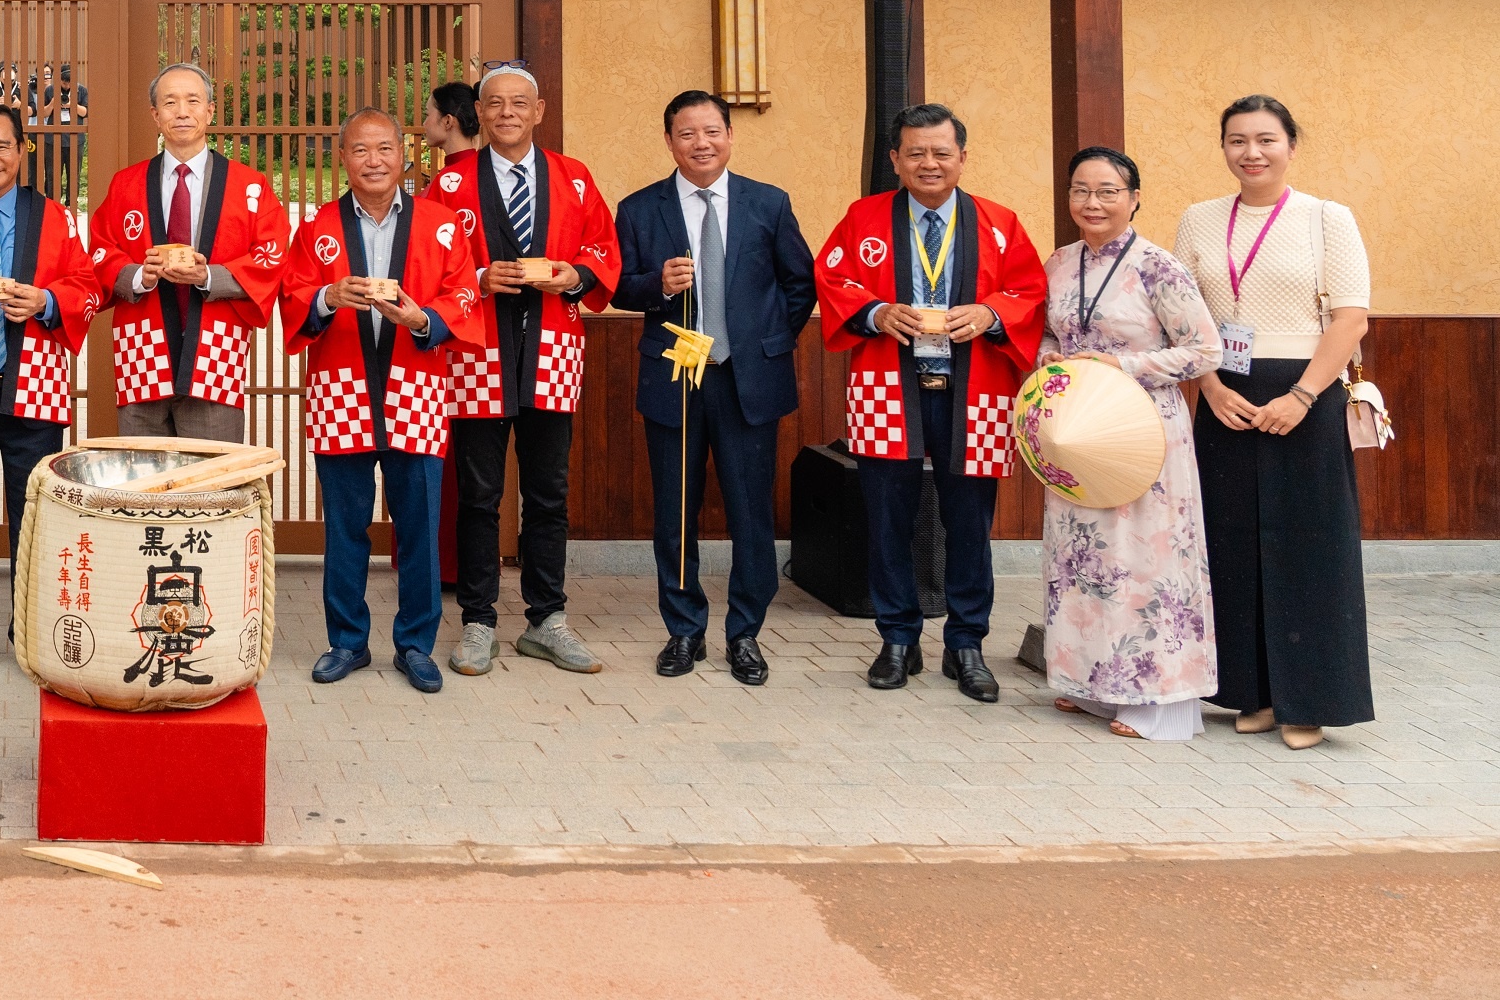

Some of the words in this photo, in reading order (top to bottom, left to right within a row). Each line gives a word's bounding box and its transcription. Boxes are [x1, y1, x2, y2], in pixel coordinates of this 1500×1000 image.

[139, 526, 213, 557] 黒松
[75, 532, 94, 612] 長生自得
